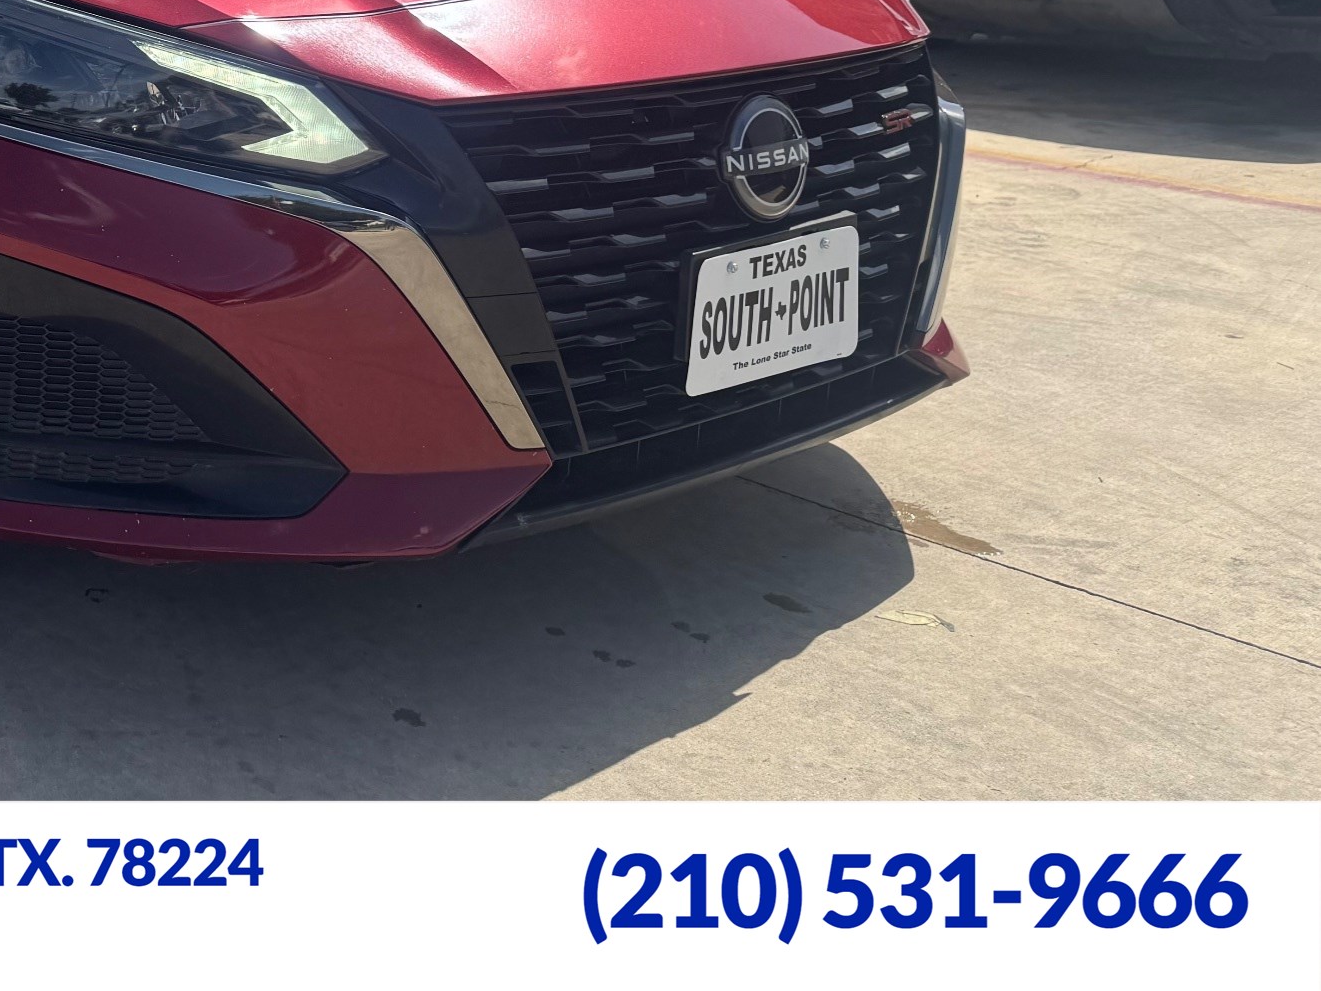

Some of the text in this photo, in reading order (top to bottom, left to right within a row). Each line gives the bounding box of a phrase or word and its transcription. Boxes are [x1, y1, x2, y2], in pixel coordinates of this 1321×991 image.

[726, 141, 809, 173] NISSAN
[749, 244, 807, 279] TEXAS
[699, 267, 850, 360] SOUTH POINT
[732, 343, 812, 371] The Lone Star State
